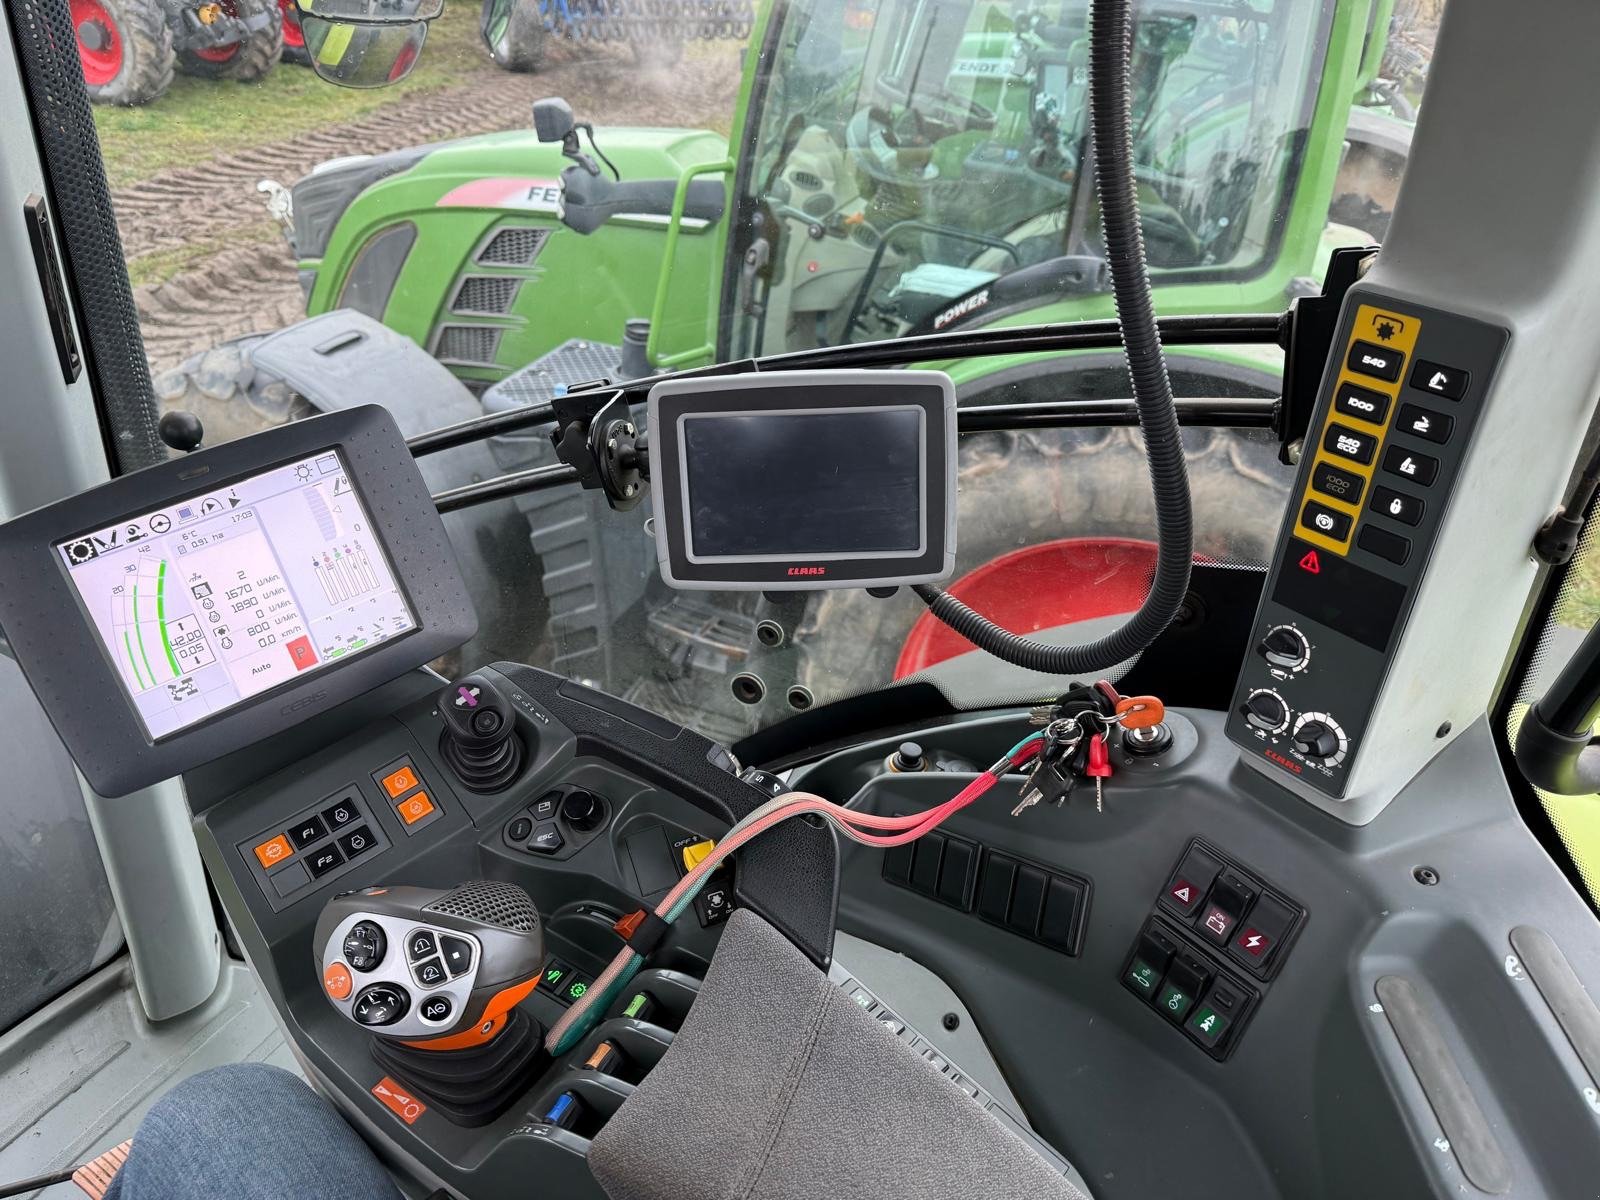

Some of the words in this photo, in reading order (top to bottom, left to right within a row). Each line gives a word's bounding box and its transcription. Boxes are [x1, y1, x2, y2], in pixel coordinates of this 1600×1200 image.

[528, 187, 558, 202] FE
[934, 289, 990, 329] POWER
[1361, 354, 1387, 369] 540
[1347, 397, 1375, 412] 1000
[1337, 434, 1361, 448] 540
[1336, 443, 1358, 455] ECO
[1326, 474, 1350, 489] 1000
[1326, 483, 1346, 494] ECO
[231, 510, 253, 523] 17:03
[138, 545, 150, 555] 42
[124, 564, 137, 573] 30
[787, 567, 825, 576] CLAAS
[237, 570, 247, 581] 2
[112, 585, 124, 595] 20
[225, 583, 253, 600] 1670
[231, 596, 259, 613] 1890
[256, 609, 265, 619] 0
[247, 621, 271, 637] 800
[281, 625, 302, 638] km/h
[169, 629, 202, 647] 42.00
[179, 643, 205, 659] 0.05
[295, 646, 305, 659] P
[251, 663, 272, 675] Auto
[281, 690, 328, 716] CEBIS
[1264, 749, 1302, 775] CLAAS
[302, 827, 314, 839] F1
[317, 854, 333, 868] F2
[1216, 912, 1225, 921] ON
[353, 956, 364, 966] F8
